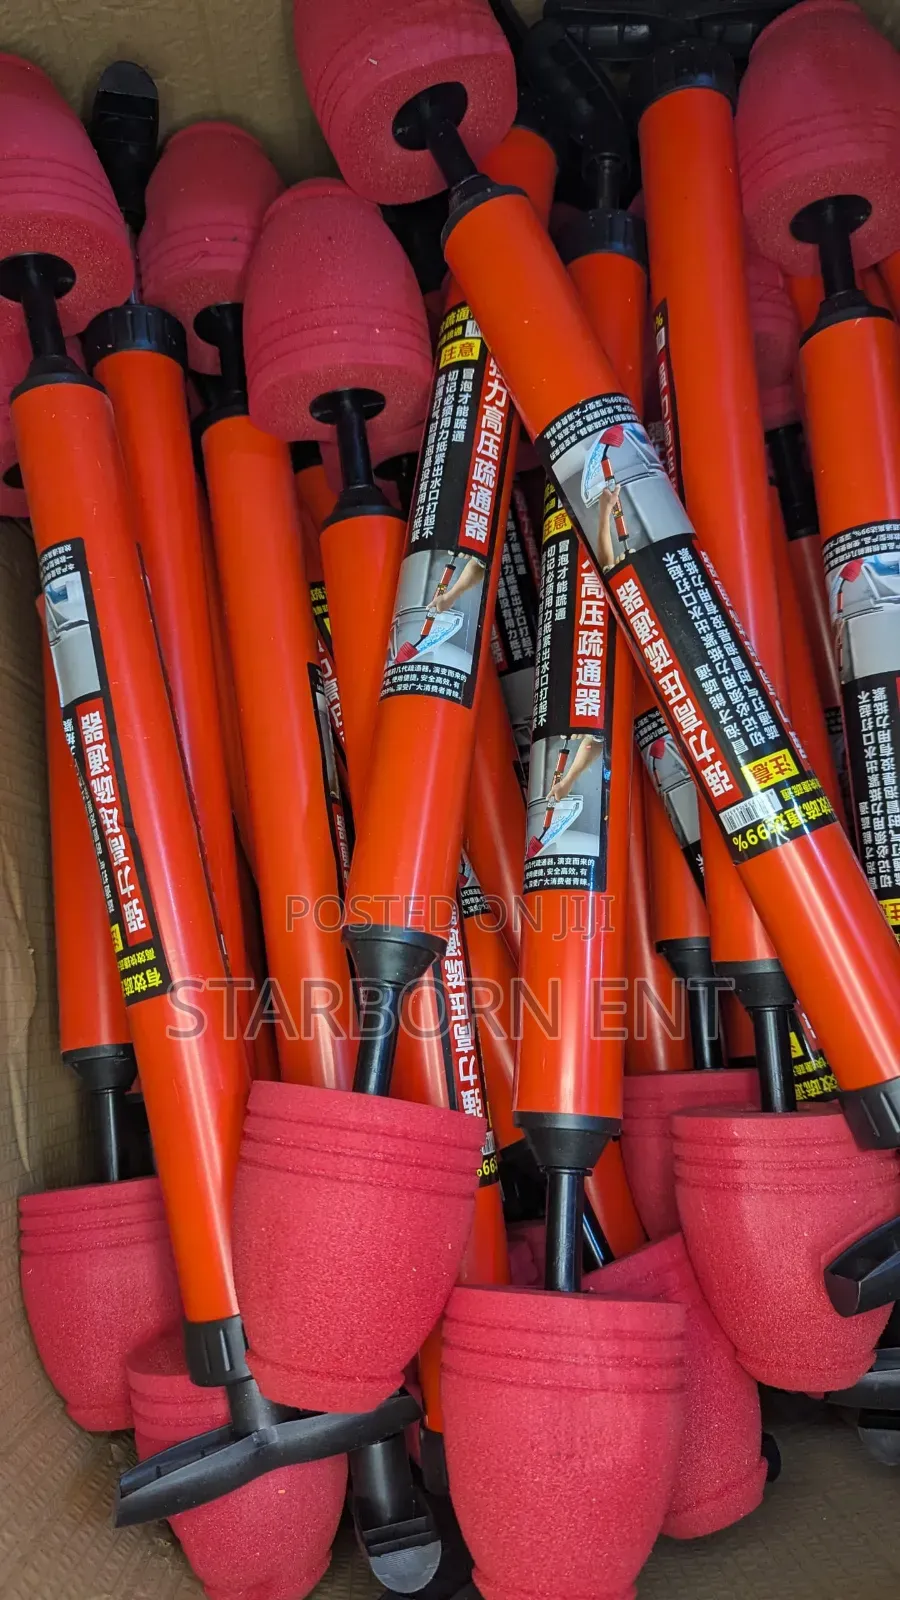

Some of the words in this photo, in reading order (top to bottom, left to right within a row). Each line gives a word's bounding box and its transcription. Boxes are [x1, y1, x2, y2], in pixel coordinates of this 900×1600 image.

[443, 342, 474, 362] 注意
[452, 368, 474, 443] 冒泡才能疏通
[422, 369, 459, 539] 切记必须用力抵紧出水口打起不
[555, 539, 569, 621] 冒泡才能疏通
[575, 559, 605, 717] 高压疏通器
[662, 553, 766, 747] 切记必须用力抵紧出水口打起不
[676, 548, 781, 738] 疏通打气时冒泡是没有用力抵紧
[616, 577, 734, 799] 强力高压疏通器
[695, 664, 749, 758] 冒泡才能疏通
[81, 709, 146, 934] 强力高压疏通器
[749, 754, 792, 785] 注意
[858, 690, 893, 888] 切记必须用力抵紧出水口打起不
[121, 967, 163, 996] 有效疏
